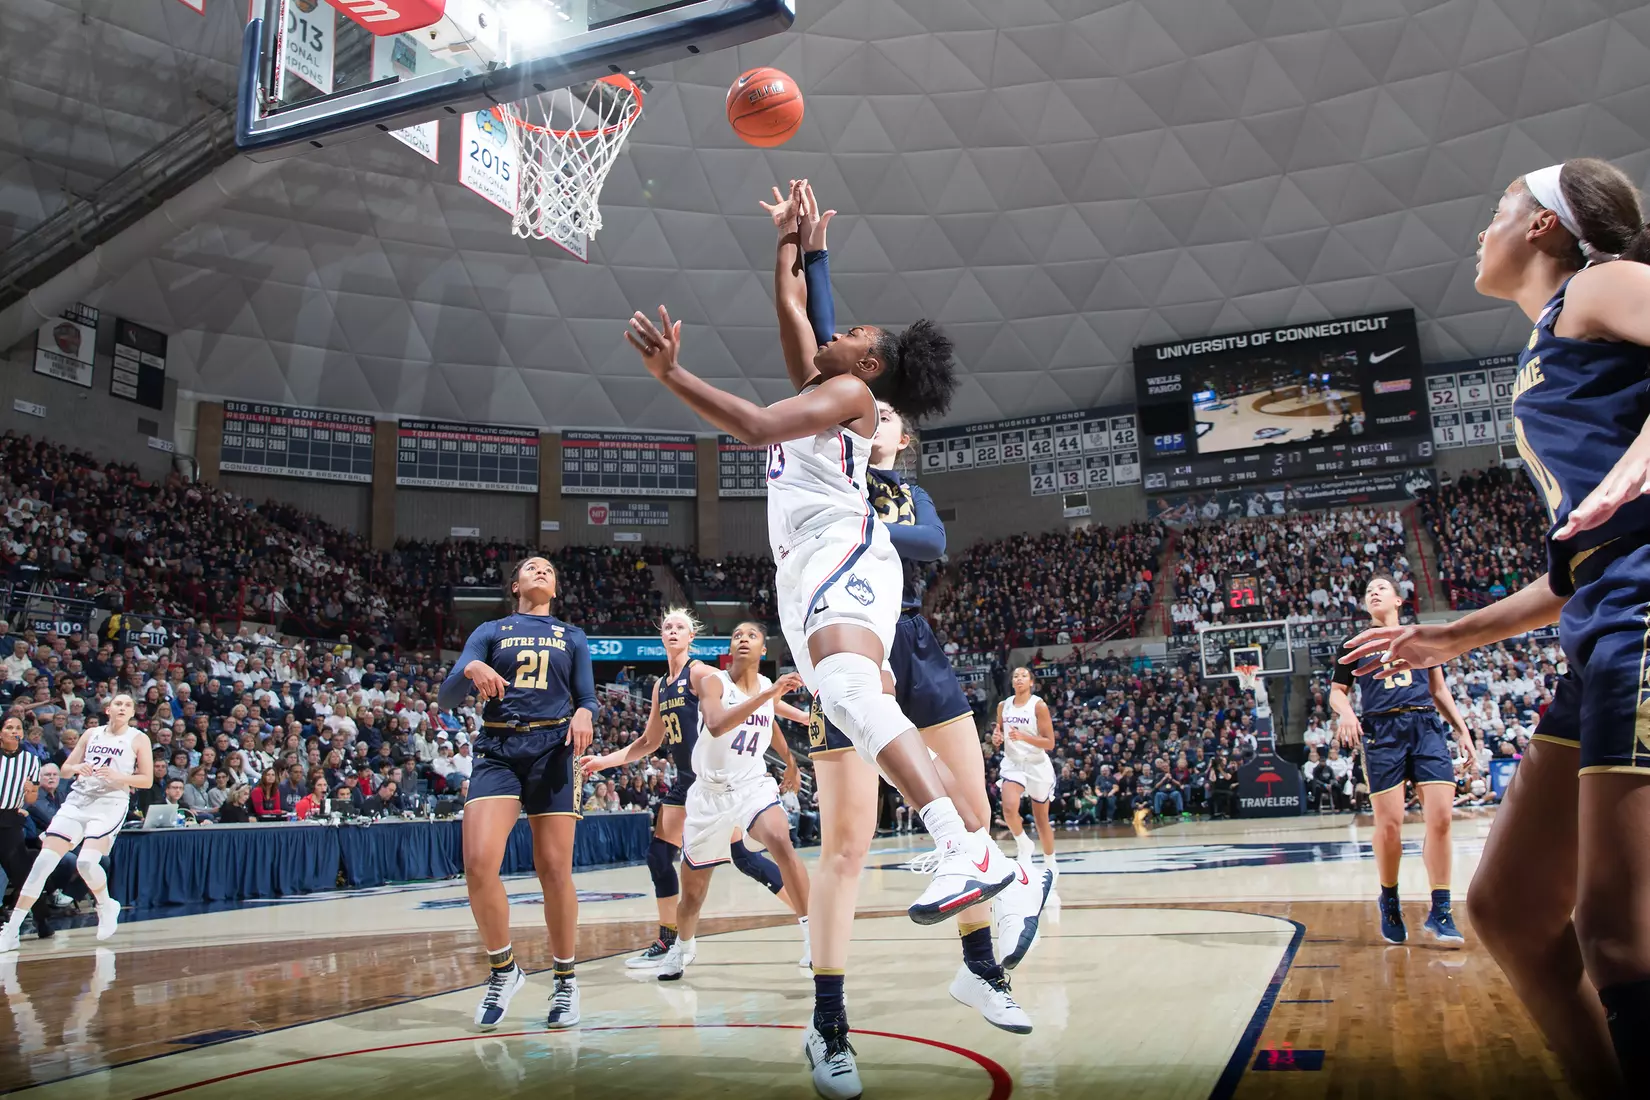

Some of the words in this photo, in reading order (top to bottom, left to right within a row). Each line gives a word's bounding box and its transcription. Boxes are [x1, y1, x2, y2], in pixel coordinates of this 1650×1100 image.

[286, 40, 320, 68] IONAL
[470, 140, 510, 181] 2015
[472, 164, 508, 196] NATIONAL
[468, 176, 511, 210] CHAMPIONS
[1156, 334, 1248, 360] UNIVERSITY
[1251, 332, 1271, 346] OF
[1276, 316, 1389, 343] CONNECTICUT
[1478, 357, 1514, 366] UCONN
[1146, 374, 1182, 386] WELLS
[1148, 384, 1182, 394] FARGO
[1433, 390, 1454, 404] 52
[227, 402, 248, 412] BIG
[254, 405, 286, 416] EAST
[293, 409, 372, 424] CONFERENCE
[1376, 414, 1412, 424] TRAVELERS
[226, 412, 271, 422] REGULAR
[276, 416, 312, 426] SEASON
[316, 421, 372, 432] CHAMPIONS
[966, 424, 994, 432] UCONN
[999, 418, 1036, 428] HUSKIES
[1056, 412, 1085, 420] HONOR
[412, 430, 472, 440] TOURNAMENT
[476, 436, 526, 444] CHAMPIONS
[437, 424, 468, 432] AMERICAN
[499, 429, 536, 437] CONFERENCE
[1115, 430, 1134, 444] 42
[1442, 428, 1454, 441] 15
[1473, 424, 1486, 438] 22
[1059, 437, 1078, 450] 44
[1154, 434, 1182, 446] CBS
[978, 447, 996, 461] 22
[1004, 444, 1023, 458] 25
[1032, 441, 1050, 454] 42
[928, 455, 940, 467] C
[957, 452, 964, 463] 9
[224, 463, 284, 473] CONNECTICUT
[316, 472, 368, 481] BASKETBALL
[1063, 472, 1078, 485] 13
[1090, 469, 1108, 482] 22
[400, 478, 454, 487] CONNECTICUT
[485, 483, 534, 491] BASKETBALL
[1034, 476, 1053, 489] 24
[1337, 488, 1358, 496] Capital
[1377, 483, 1396, 491] World
[592, 510, 605, 518] NIT
[1230, 588, 1254, 608] 27
[36, 621, 51, 630] SEC
[501, 637, 535, 649] NOTRE
[538, 638, 566, 651] DAME
[514, 650, 550, 689] 21
[1042, 668, 1058, 676] 114
[970, 674, 984, 682] 113
[668, 697, 685, 708] DAME
[1002, 716, 1030, 724] UCONN
[731, 730, 760, 756] 44
[88, 746, 123, 756] UCONN
[1240, 796, 1299, 808] TRAVELERS
